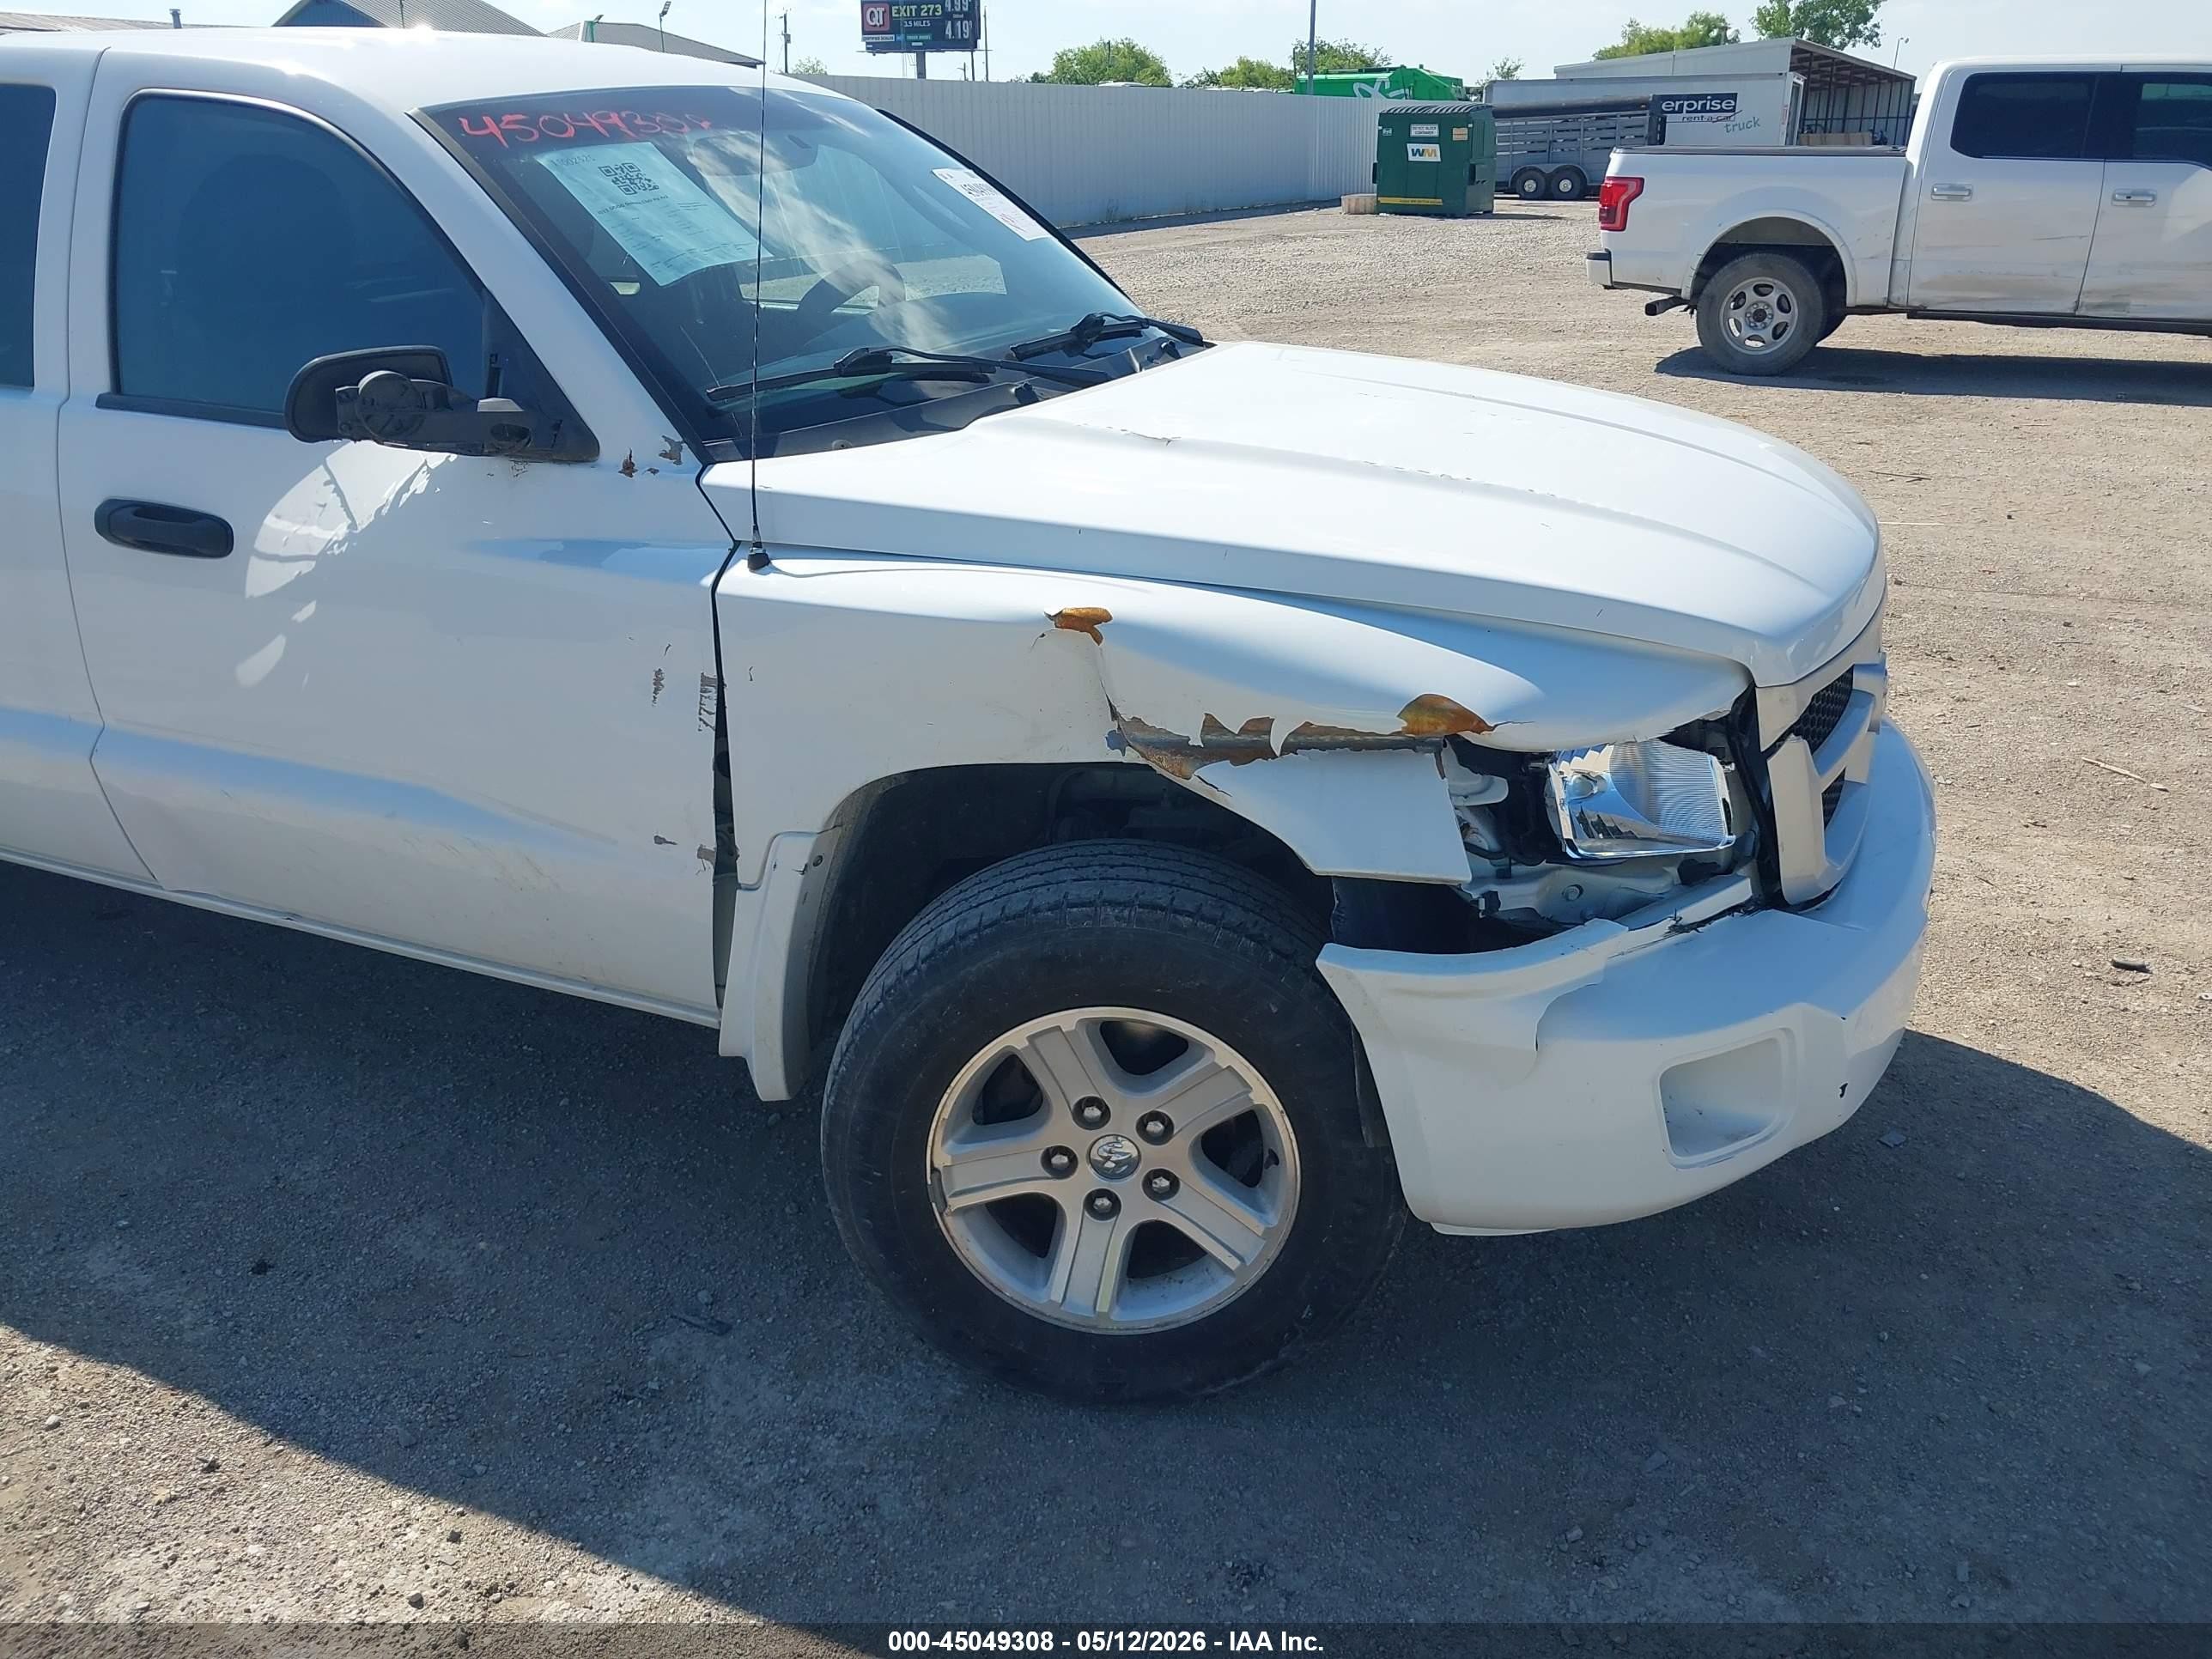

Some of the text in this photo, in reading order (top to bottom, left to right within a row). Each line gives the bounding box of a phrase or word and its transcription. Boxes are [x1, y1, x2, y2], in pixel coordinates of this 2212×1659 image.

[866, 7, 885, 27] QT
[891, 5, 917, 17] EXIT
[921, 4, 942, 16] 273
[1661, 95, 1735, 114] erprise
[1724, 116, 1761, 133] truck
[1411, 148, 1437, 157] WM
